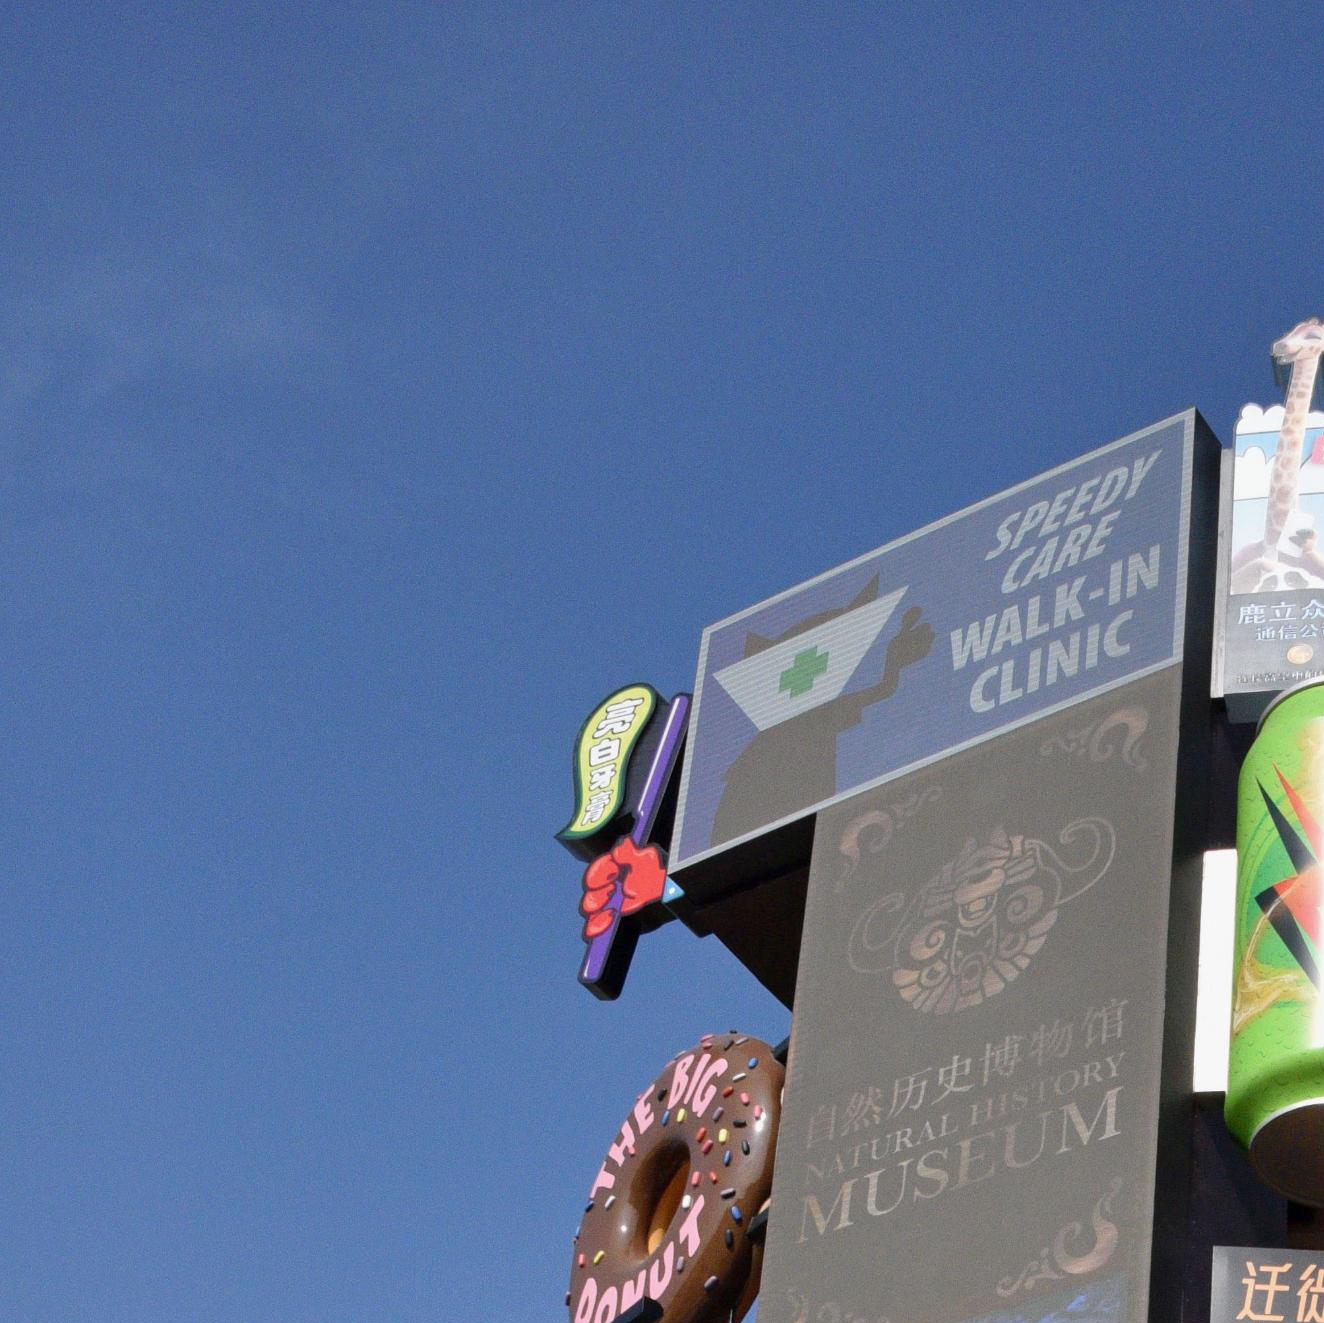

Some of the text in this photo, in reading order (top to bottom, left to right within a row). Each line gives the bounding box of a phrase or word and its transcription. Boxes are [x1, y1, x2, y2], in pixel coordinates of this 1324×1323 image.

[985, 448, 1163, 561] SPEEDY
[1001, 509, 1121, 593] CARE
[951, 544, 1160, 671] WALK-IN
[969, 609, 1133, 713] CLINIC
[581, 698, 645, 826] 亮白牙膏
[590, 1053, 728, 1198] THE BIG
[804, 1051, 1126, 1184] NATURAL HISTORY
[806, 998, 1128, 1149] 自然历史博物馆
[799, 1086, 1124, 1243] MUSEUM
